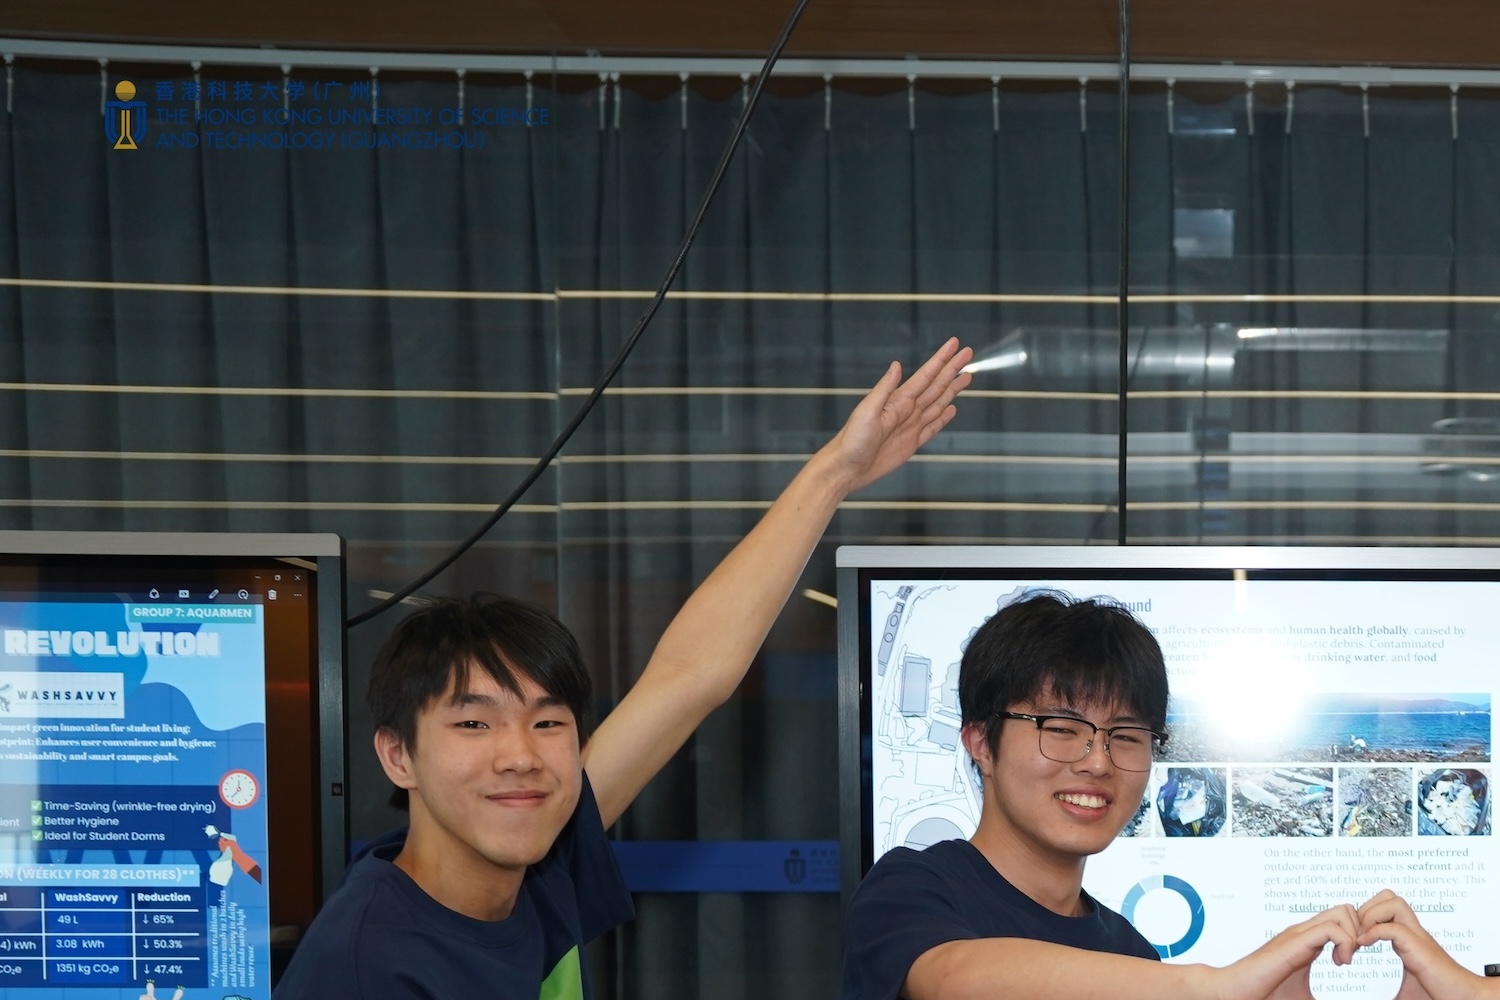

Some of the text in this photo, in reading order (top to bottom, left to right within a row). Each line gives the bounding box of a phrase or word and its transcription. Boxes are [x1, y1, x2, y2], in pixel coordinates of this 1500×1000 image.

[133, 607, 252, 619] GROUP 7: AQUARMEN
[1289, 625, 1326, 635] human
[1330, 625, 1364, 635] health
[1414, 625, 1451, 635] caused
[1454, 625, 1466, 638] by
[4, 630, 221, 657] REVOLUTION
[17, 690, 117, 701] WASHSAVVY
[32, 724, 59, 734] green
[60, 723, 110, 732] innovation
[110, 723, 126, 732] for
[126, 723, 161, 732] student
[36, 738, 80, 747] Enhances
[103, 738, 159, 747] convenience
[160, 738, 177, 747] and
[4, 752, 67, 763] sustainability
[69, 752, 87, 760] and
[116, 754, 152, 763] campus
[43, 799, 216, 814] Time-Saving (wrinkle-free drying)
[44, 816, 120, 829] Better Hygiene
[44, 831, 165, 841] Ideal for Student Dorms
[1264, 848, 1280, 857] On
[1283, 848, 1300, 857] the
[1303, 848, 1332, 857] other
[1367, 848, 1384, 857] the
[1388, 848, 1414, 857] most
[1417, 848, 1469, 859] preferred
[17, 868, 72, 881] (WEEKLY
[75, 869, 100, 880] FOR
[102, 869, 117, 880] 28
[54, 892, 191, 904] WashSavvy Reduction
[57, 914, 174, 924] 49 L 65%
[13, 939, 183, 950] kWh 3.08 kWh 50.3%
[56, 963, 76, 973] 1351
[78, 964, 91, 975] kg
[154, 964, 183, 974] 47.4%
